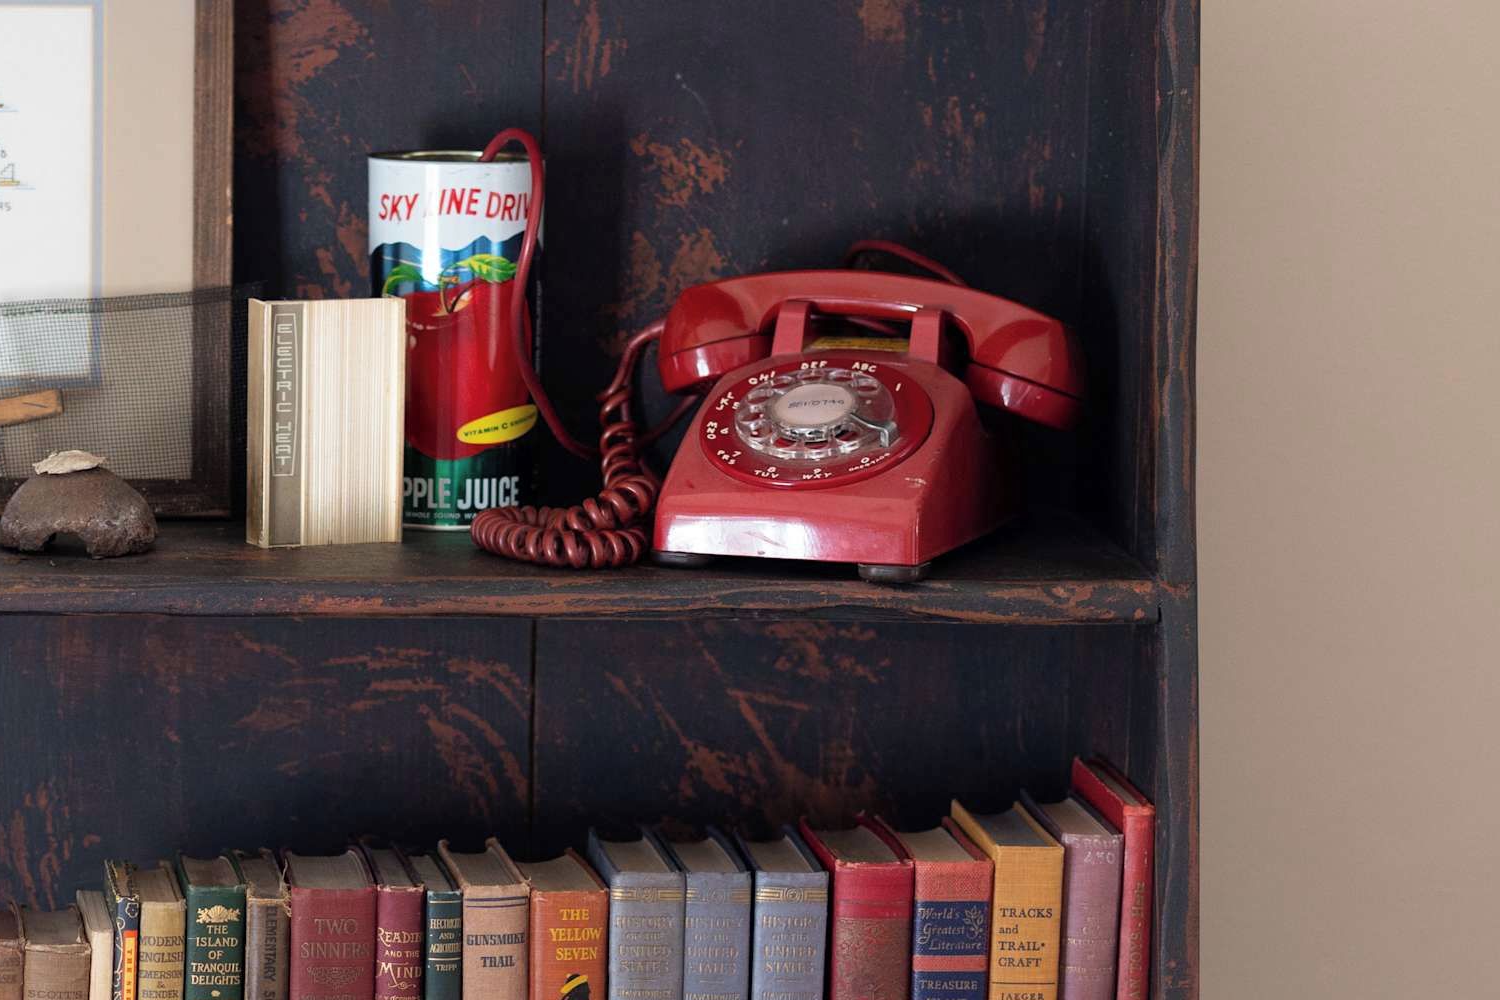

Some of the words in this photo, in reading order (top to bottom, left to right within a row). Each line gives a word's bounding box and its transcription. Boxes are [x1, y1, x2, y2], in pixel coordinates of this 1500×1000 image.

[275, 323, 293, 413] ELECTRIC
[801, 360, 828, 370] DEF
[852, 361, 878, 374] ABC
[748, 371, 776, 386] GHI
[463, 425, 500, 437] VITAMIN
[275, 421, 293, 466] HEAT
[753, 469, 780, 480] TUV
[801, 472, 833, 481] WXY
[403, 476, 452, 510] PPLE
[456, 476, 520, 511] JUICE
[433, 512, 461, 520] SOUND
[559, 908, 590, 921] THE
[917, 908, 961, 920] World's
[1000, 907, 1053, 919] TRACKS
[207, 925, 229, 935] THE
[314, 918, 358, 936] TWO
[998, 924, 1019, 935] and
[466, 932, 525, 946] GUNSMOKE
[549, 926, 603, 942] YELLOW
[917, 922, 965, 945] Greatest
[139, 935, 185, 947] MODERN
[195, 938, 239, 948] ISLAND
[262, 905, 278, 983] ELEMENTARY
[929, 939, 983, 951] Literature
[139, 950, 184, 963] ENGLISH
[207, 951, 224, 960] OF
[301, 942, 372, 959] SINNERS
[384, 950, 403, 959] AND
[405, 950, 420, 959] THE
[555, 947, 598, 961] SEVEN
[480, 956, 516, 968] TRAIL
[998, 957, 1043, 968] CRAFT
[139, 968, 182, 979] EMERSON
[190, 962, 242, 975] TRANQUIL
[374, 959, 422, 989] MIND
[156, 981, 165, 989] &
[191, 975, 241, 986] DELIGHTS
[919, 979, 979, 991] TREASURE
[142, 989, 179, 999] BENDER
